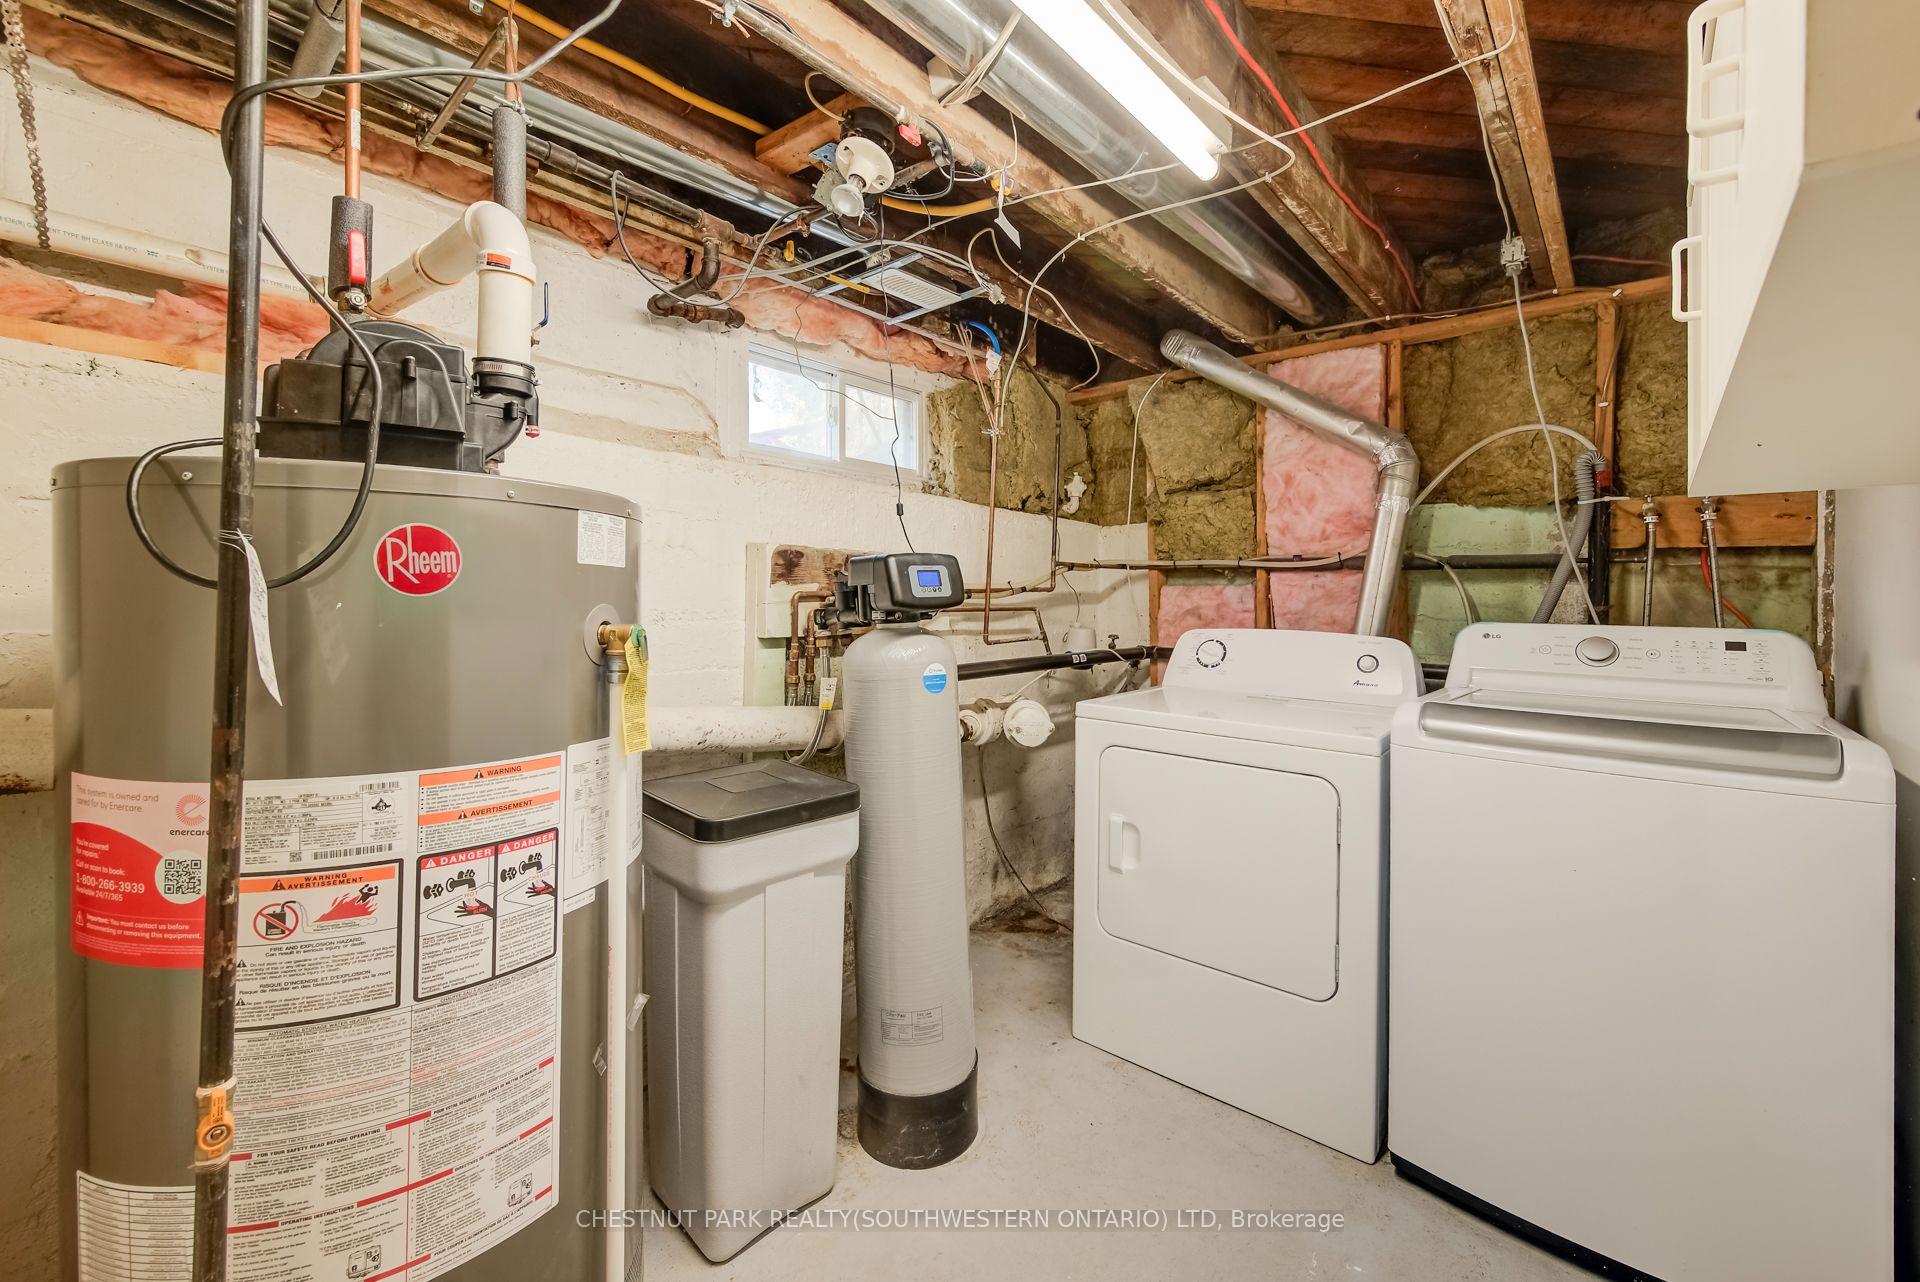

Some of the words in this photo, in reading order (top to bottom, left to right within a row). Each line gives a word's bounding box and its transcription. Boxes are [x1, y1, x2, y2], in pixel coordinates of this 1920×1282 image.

[386, 525, 457, 583] Rheem
[487, 766, 522, 776] WARNING
[143, 793, 159, 802] and
[101, 800, 109, 810] by
[110, 801, 143, 812] Enercare.
[470, 799, 533, 817] AVERTISSEMENT
[514, 833, 555, 849] DANGER
[440, 848, 492, 865] DANGER
[76, 872, 145, 894] 1-800-266-3939
[287, 876, 364, 890] AVERTISSEMENT
[304, 873, 348, 882] WARNING
[95, 891, 123, 901] 24/7/365
[300, 941, 335, 949] EXPLOSION
[303, 946, 324, 954] serious
[284, 978, 319, 986] D'INCENDIE
[330, 970, 371, 980] D'EXPLOSION
[286, 1146, 308, 1154] SAFETY
[310, 1142, 325, 1150] READ
[326, 1137, 348, 1146] BEFORE
[350, 1129, 381, 1140] OPERATING
[281, 1216, 312, 1226] OPERATING
[313, 1205, 355, 1218] INSTRUCTIONS
